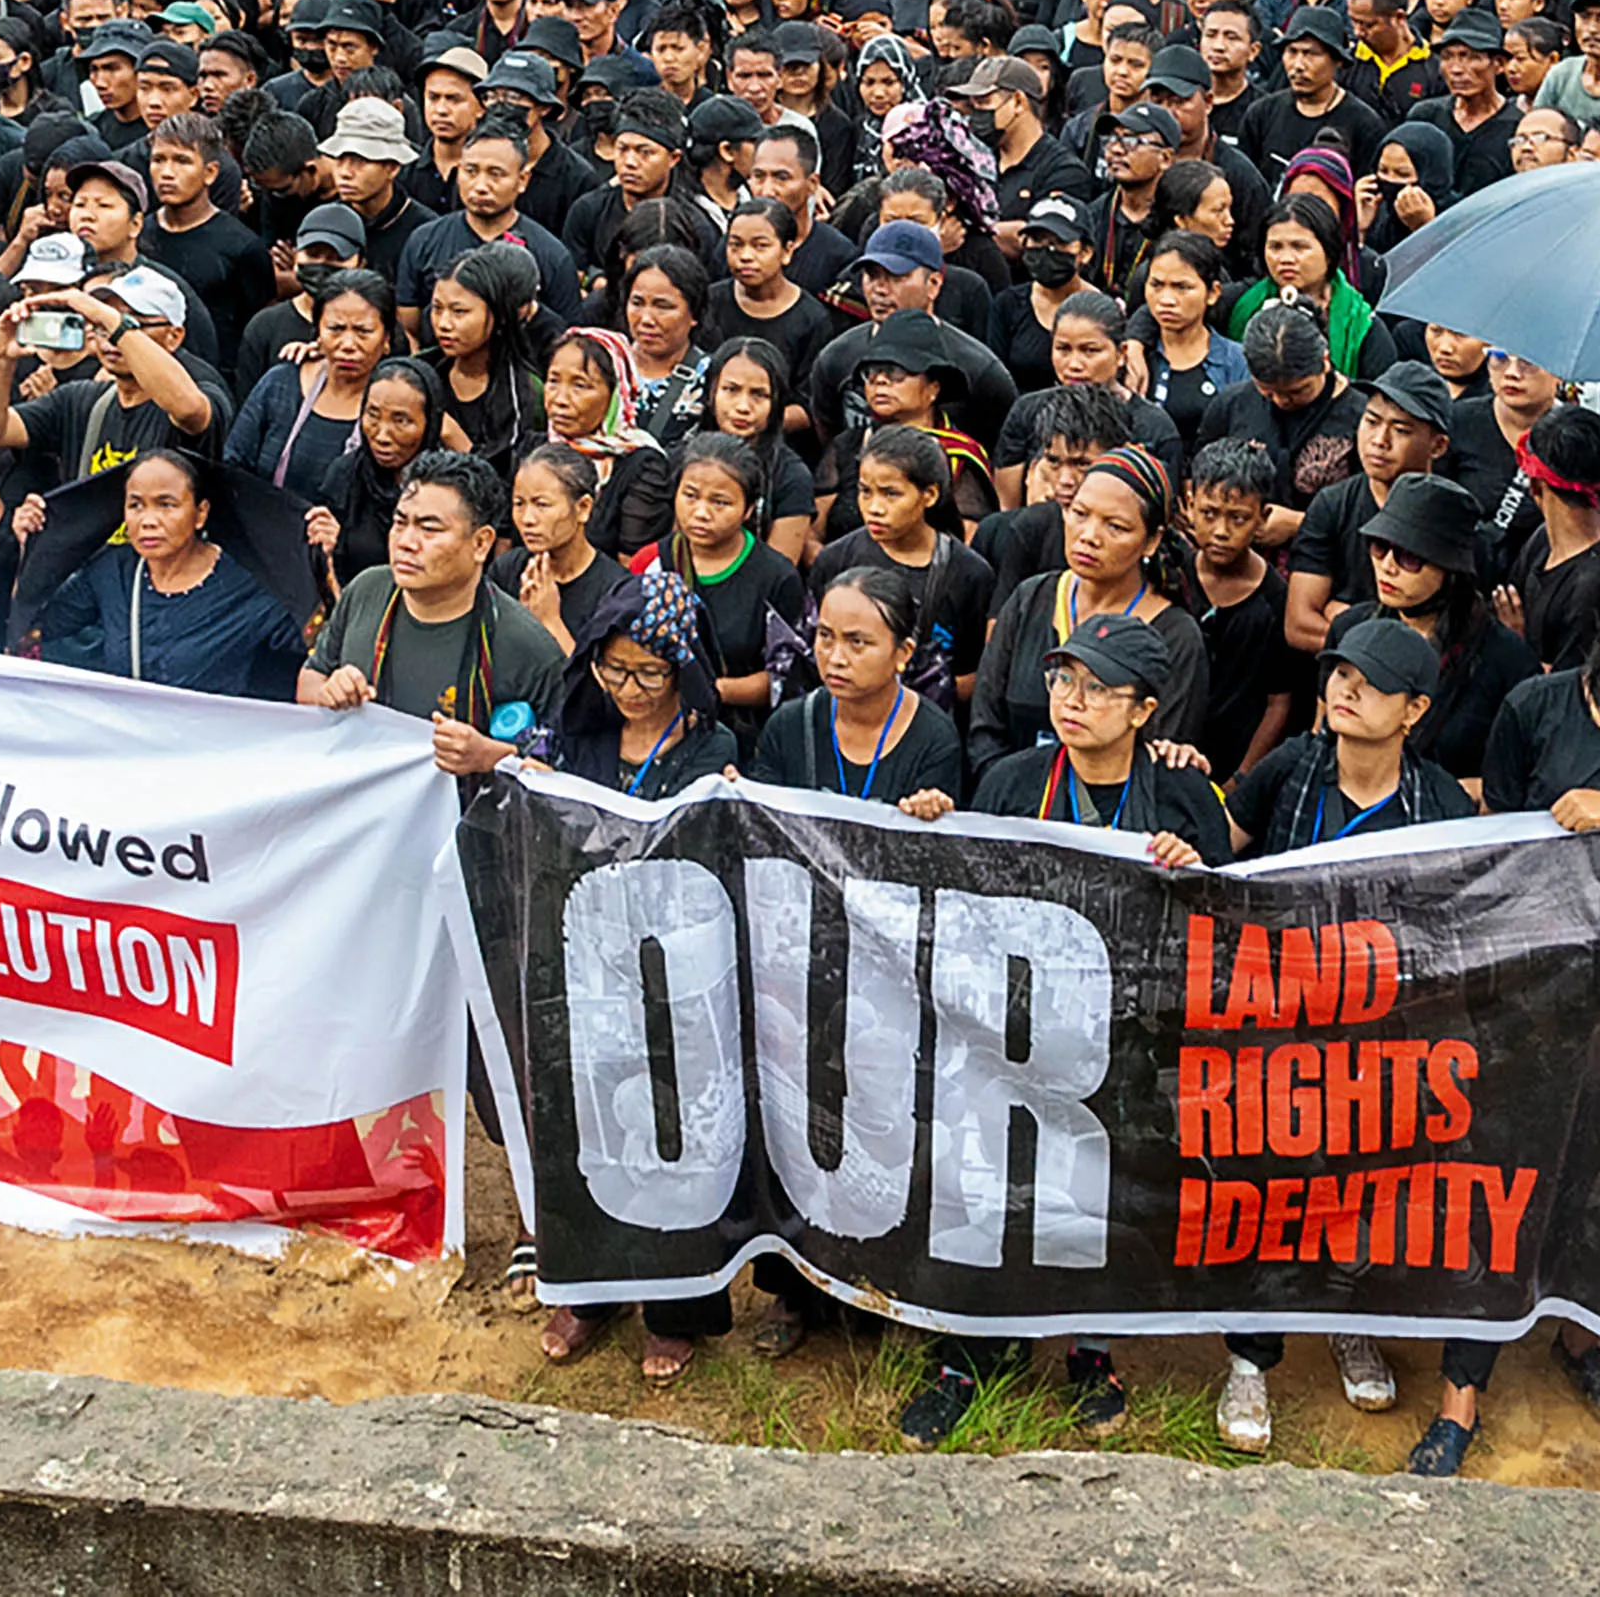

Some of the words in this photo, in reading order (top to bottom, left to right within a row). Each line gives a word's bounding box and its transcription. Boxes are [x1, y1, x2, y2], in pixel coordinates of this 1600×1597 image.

[1184, 912, 1400, 1030] LAND
[562, 857, 1112, 1269] OUR
[1177, 1038, 1479, 1159] RIGHTS
[1173, 1160, 1539, 1274] IDENTITY
